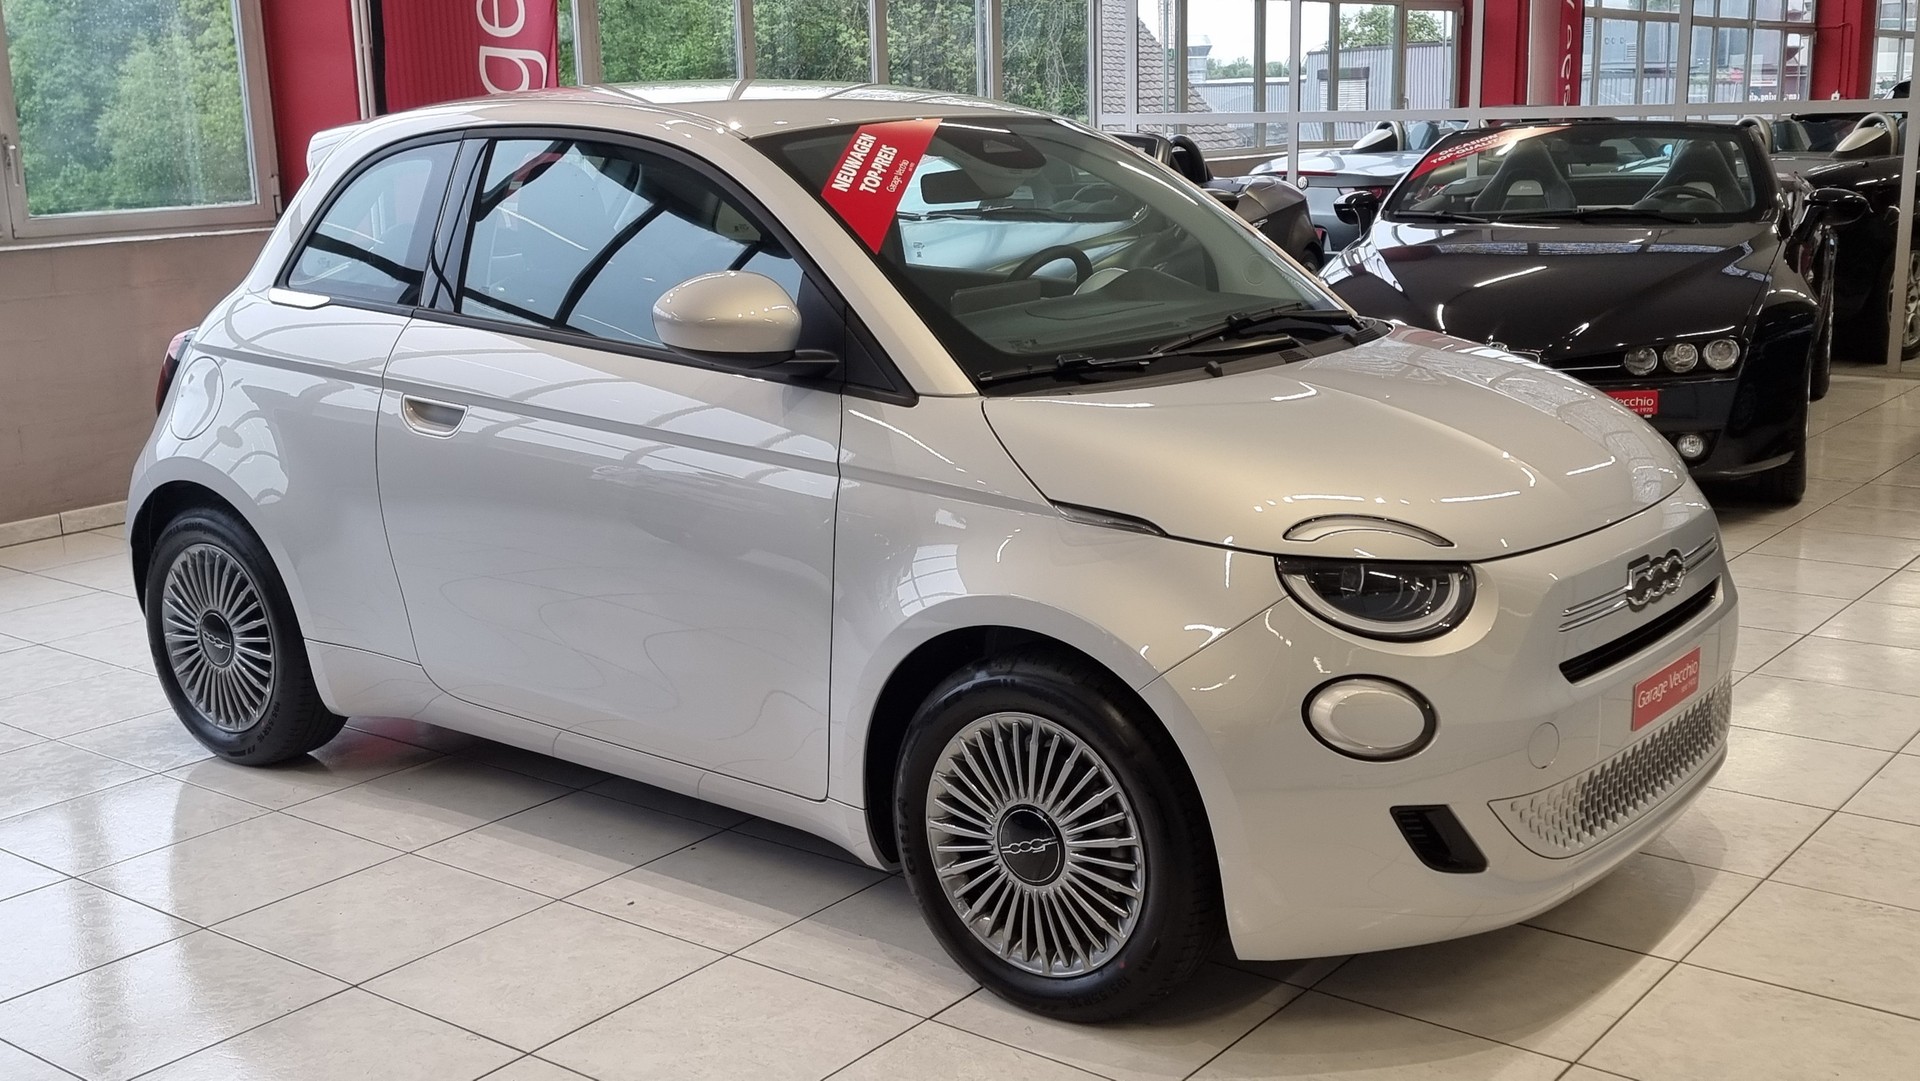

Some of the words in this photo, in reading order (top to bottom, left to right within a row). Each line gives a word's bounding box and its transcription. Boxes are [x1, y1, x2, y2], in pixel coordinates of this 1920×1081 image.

[831, 133, 877, 193] NEUWAGEN
[859, 144, 898, 193] TOP-PREIS
[1439, 134, 1498, 156] OCCASION
[1626, 553, 1686, 607] 500
[1638, 680, 1669, 709] Garage
[1669, 660, 1699, 689] Vecchio
